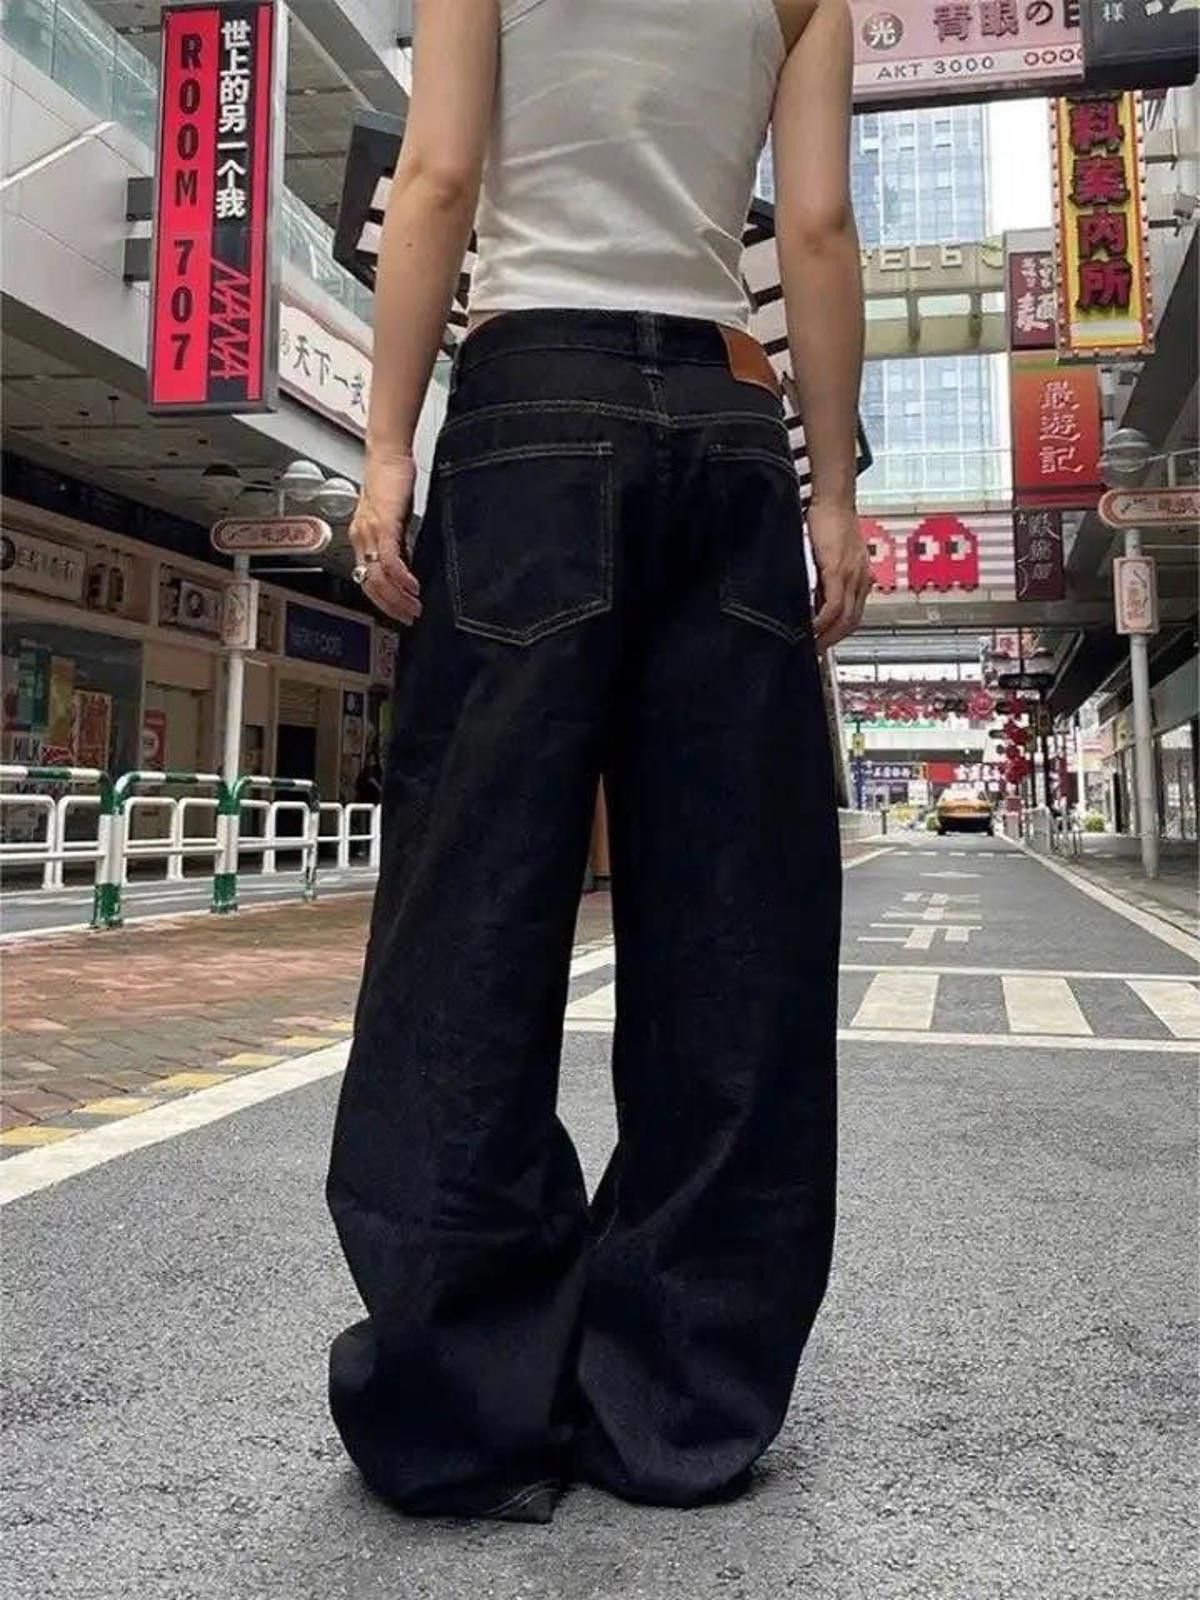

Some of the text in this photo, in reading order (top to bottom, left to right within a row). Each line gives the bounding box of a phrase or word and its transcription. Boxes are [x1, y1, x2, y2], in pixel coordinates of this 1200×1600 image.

[868, 22, 897, 48] 光
[876, 56, 995, 82] AKT 3000
[215, 19, 251, 219] 世上的另一个我
[170, 33, 202, 371] ROOM 707
